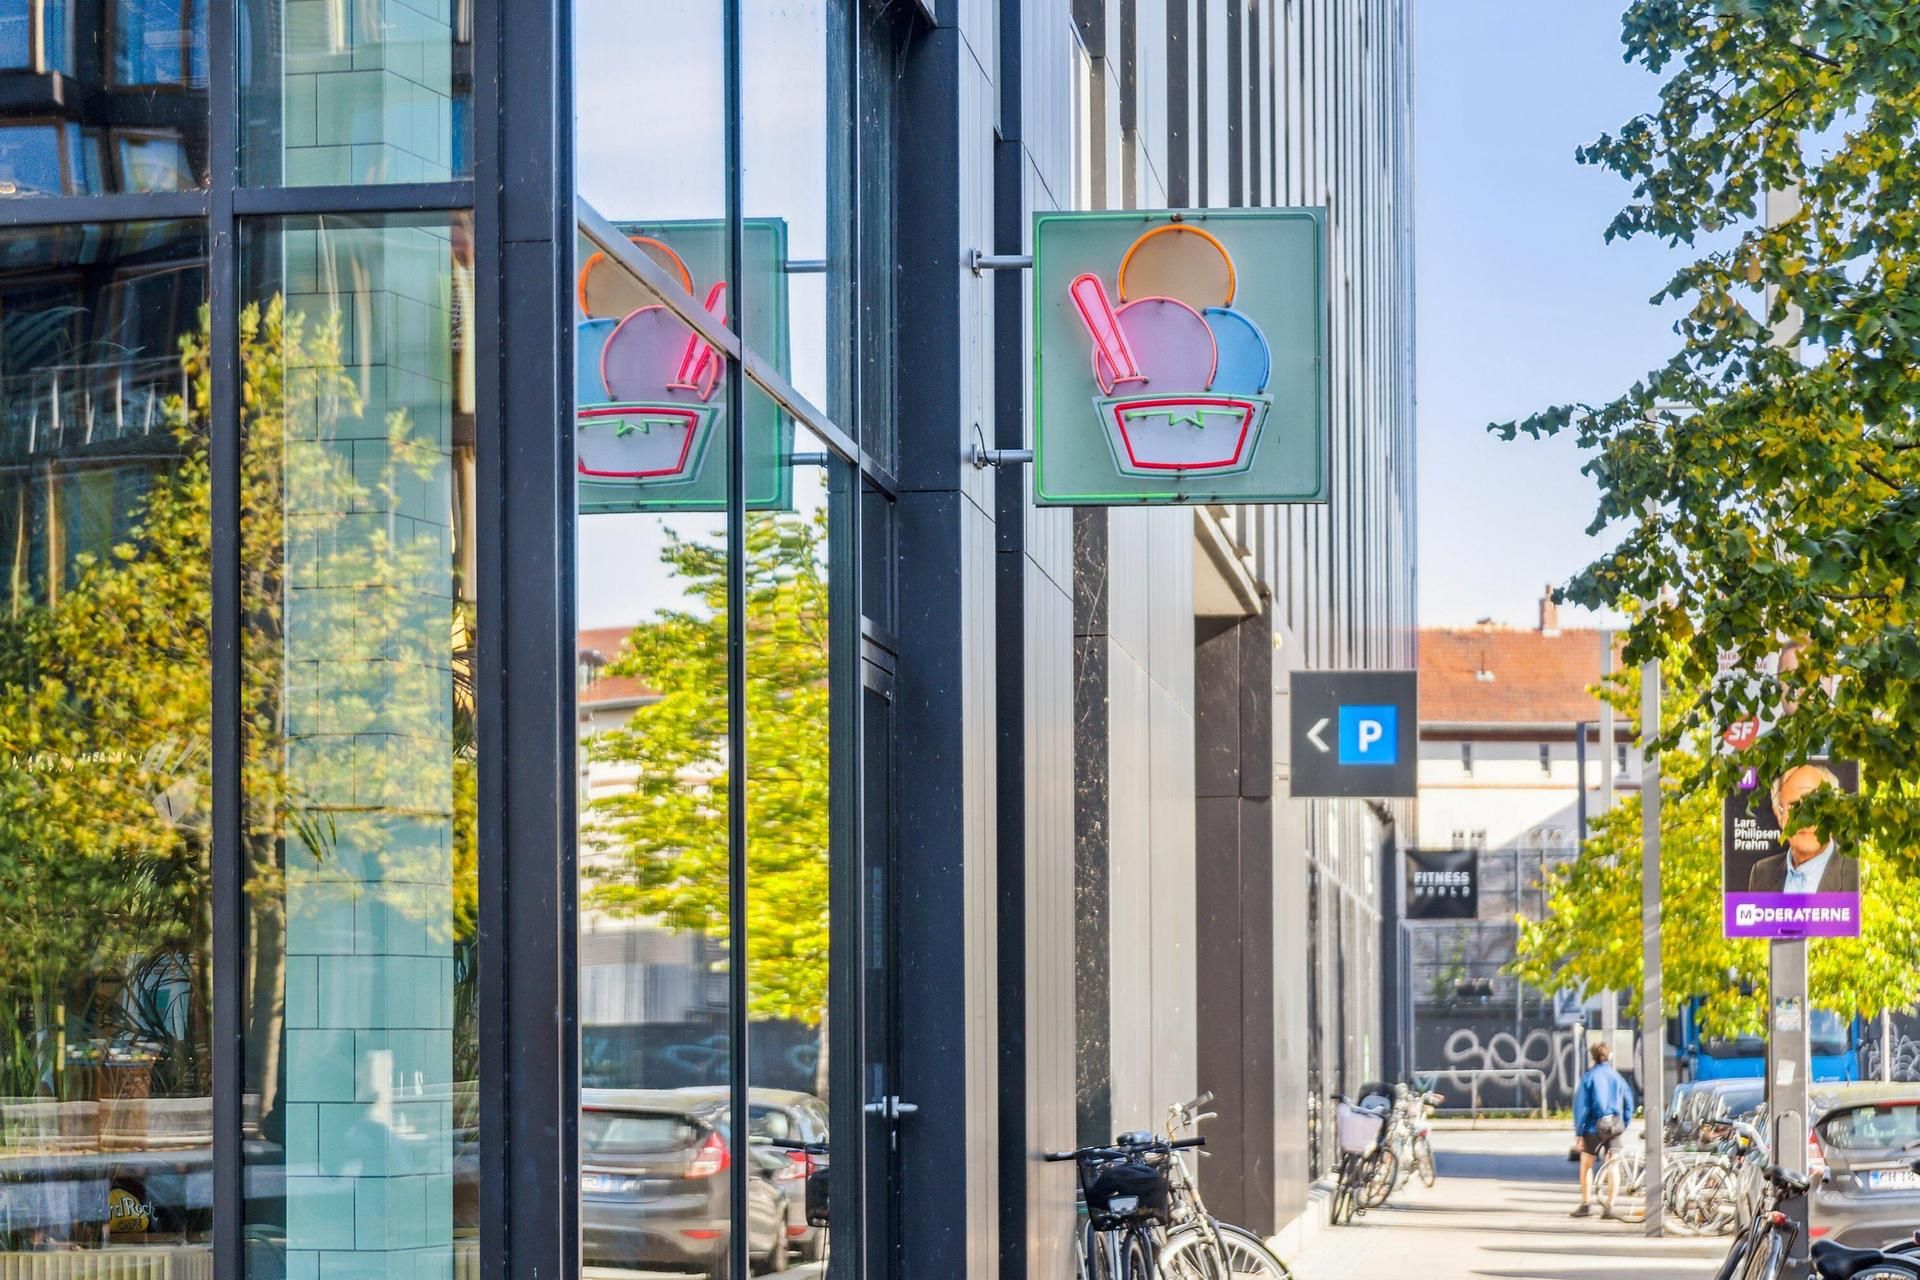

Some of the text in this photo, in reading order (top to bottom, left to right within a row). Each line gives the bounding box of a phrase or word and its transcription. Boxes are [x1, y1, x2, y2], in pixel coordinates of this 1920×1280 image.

[1358, 720, 1383, 752] P
[1728, 721, 1754, 740] SF
[1735, 817, 1757, 829] Lars
[1735, 826, 1781, 840] Philipsen
[1735, 838, 1769, 850] Prahm
[1414, 871, 1470, 885] FITNESS
[1415, 885, 1470, 898] WORLD
[1737, 904, 1851, 924] MODERATERNE
[122, 1197, 158, 1220] Rock
